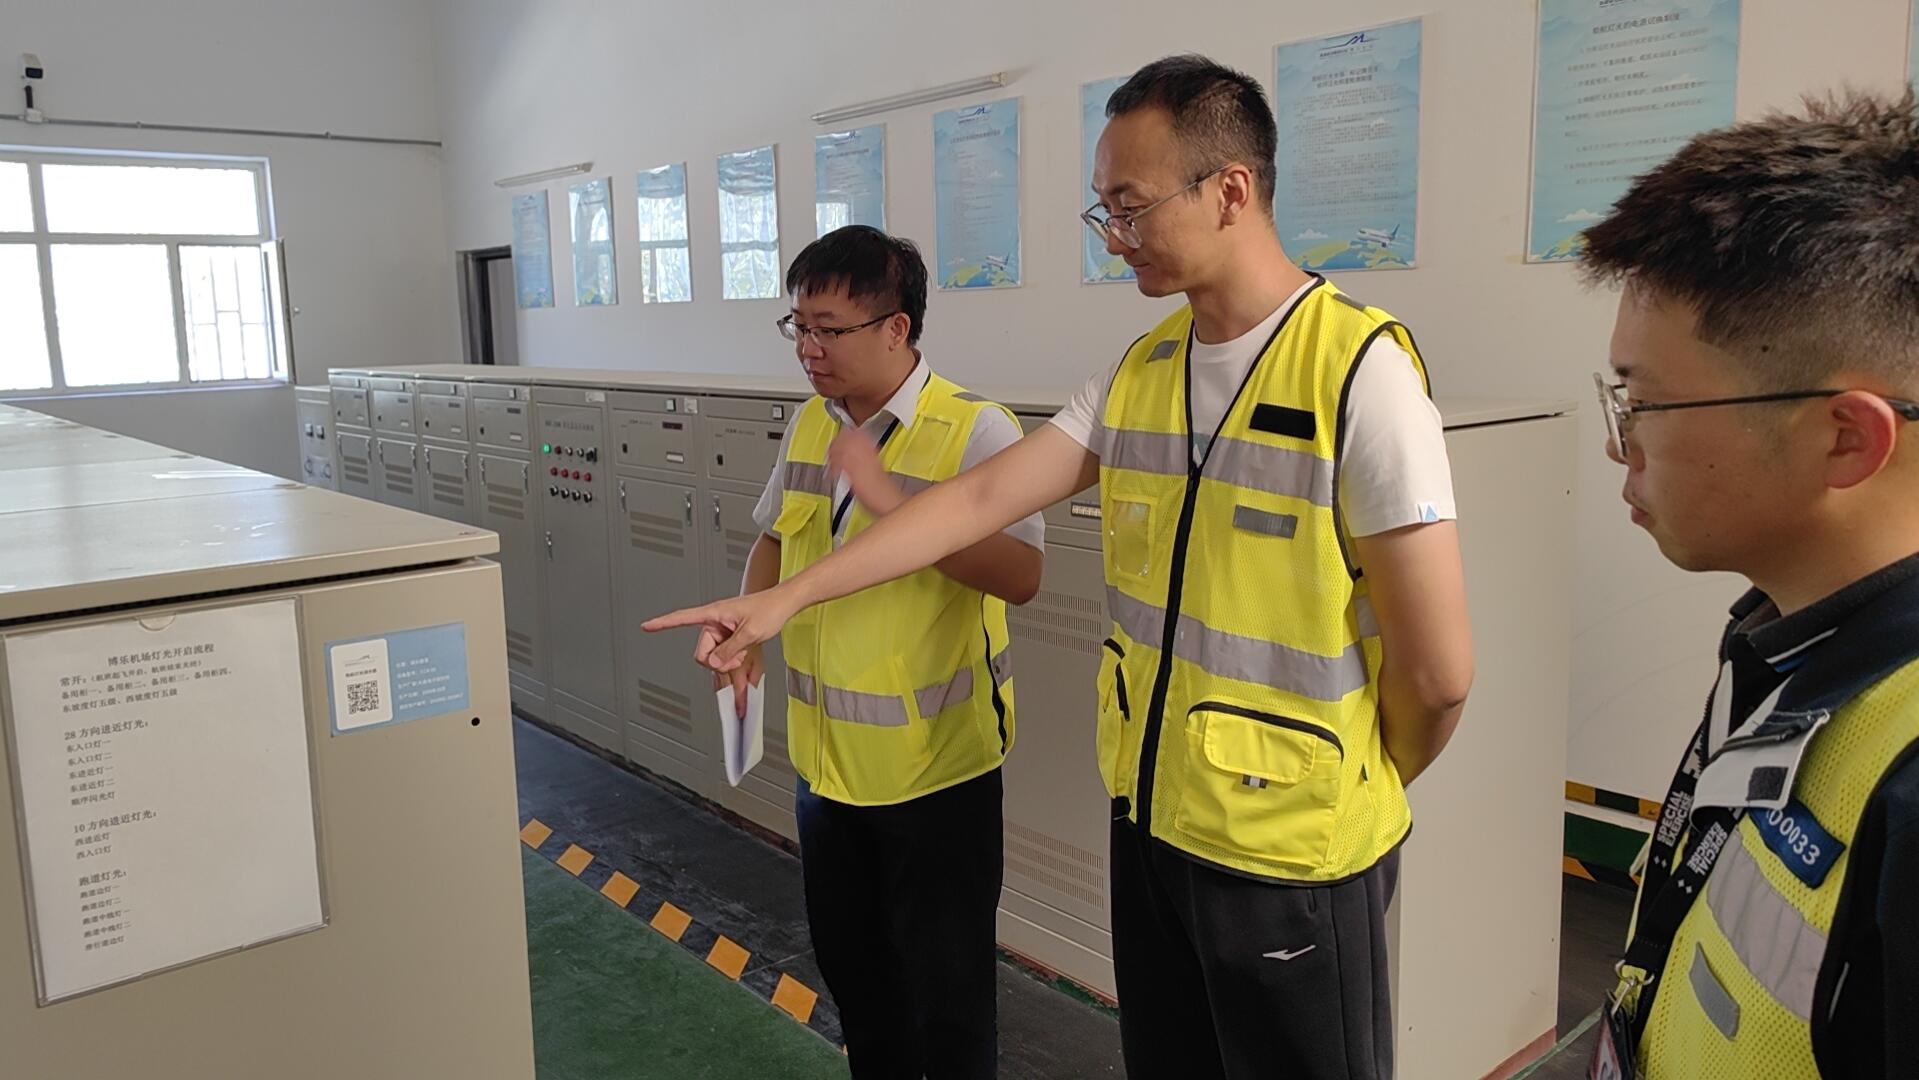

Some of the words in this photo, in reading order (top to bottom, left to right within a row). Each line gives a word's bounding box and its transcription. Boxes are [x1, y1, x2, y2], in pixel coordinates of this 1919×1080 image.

[107, 643, 215, 667] 博乐机场灯光开启流程
[66, 739, 112, 753] 东入口灯一
[67, 752, 113, 766] 东入口灯二
[69, 766, 114, 779] 东进近灯一
[70, 778, 116, 793] 东进近灯二
[1656, 789, 1685, 844] SPECIAL
[1664, 791, 1695, 848] EXERCISE
[75, 832, 111, 846] 西进近灯
[1687, 821, 1724, 870] EXERCISE
[1766, 808, 1820, 866] 00033
[76, 845, 112, 860] 西入口灯
[1694, 827, 1729, 876] SPECIAL
